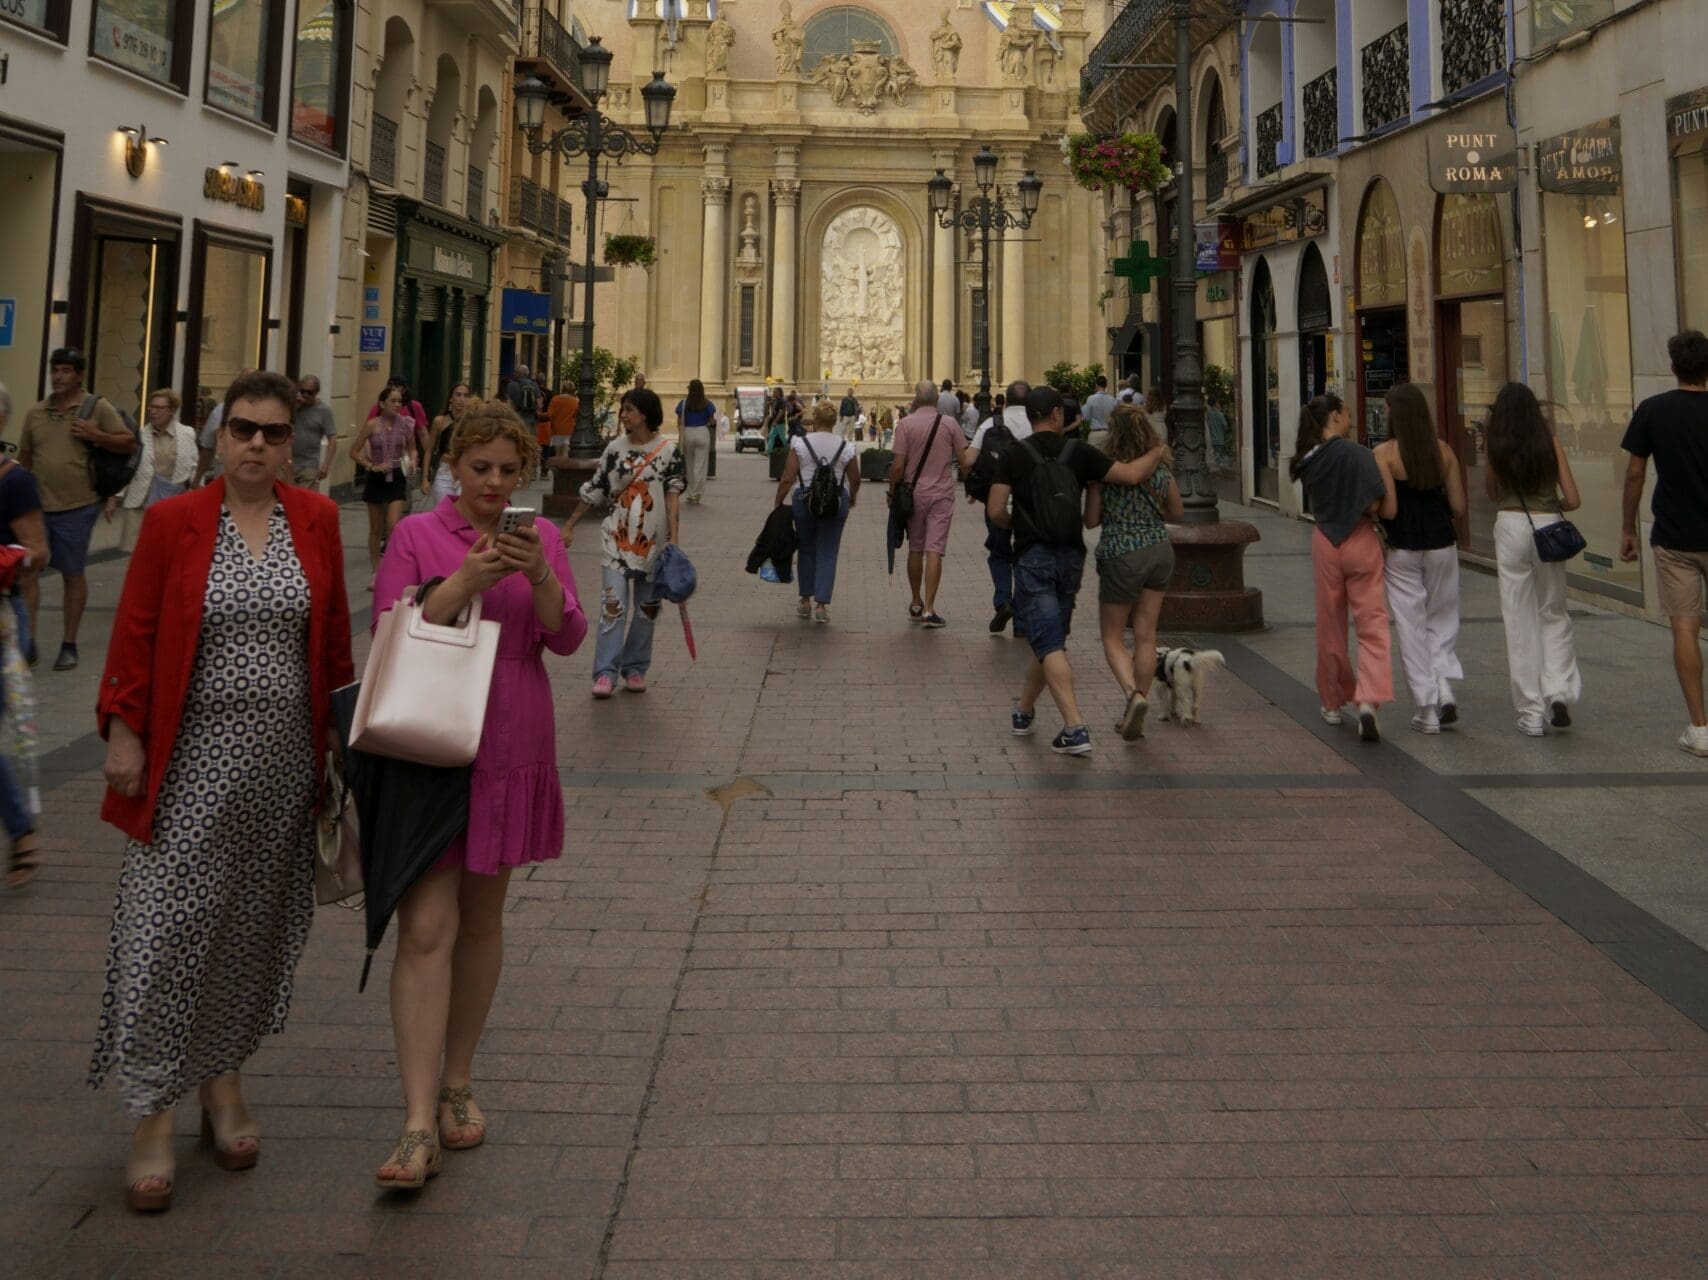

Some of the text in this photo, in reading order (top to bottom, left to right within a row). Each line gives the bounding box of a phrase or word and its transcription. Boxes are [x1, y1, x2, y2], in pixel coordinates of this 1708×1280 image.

[1674, 104, 1708, 137] PUNT
[1446, 134, 1497, 148] PUNT
[1446, 166, 1503, 182] ROMA
[362, 328, 384, 338] VUT
